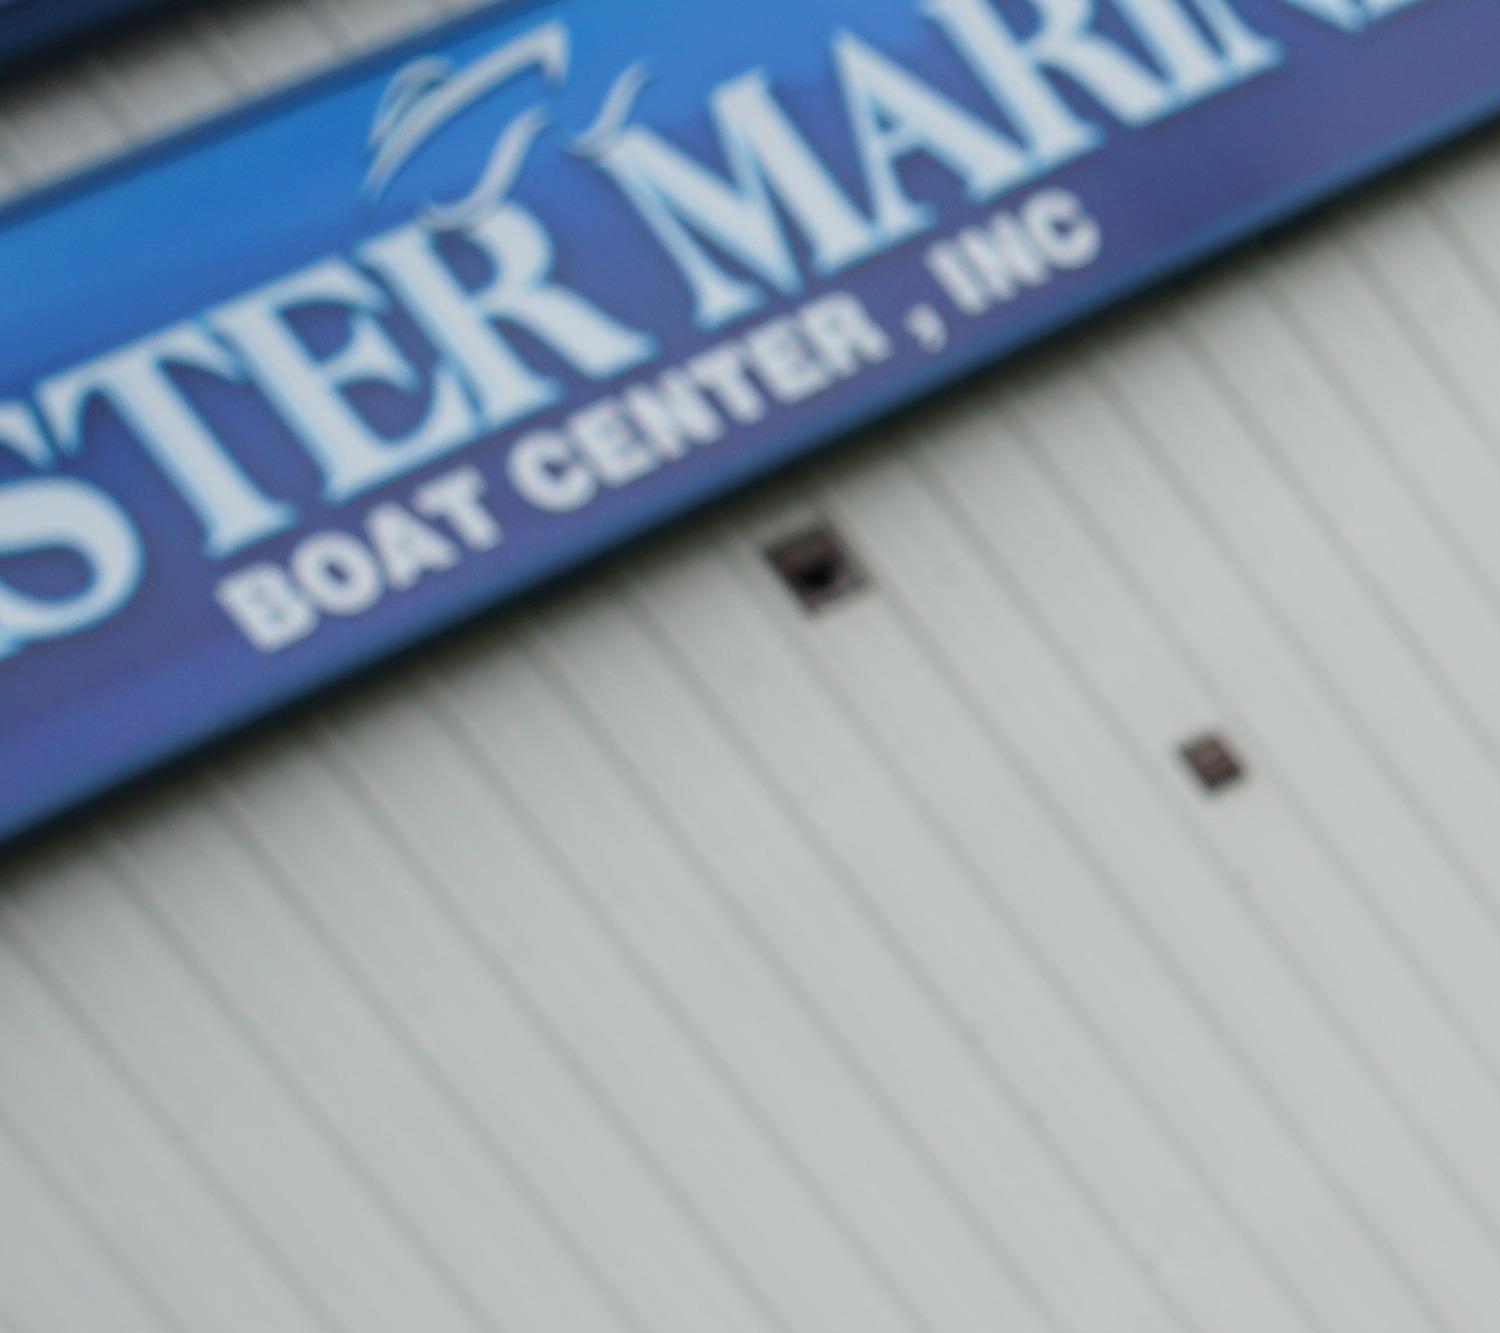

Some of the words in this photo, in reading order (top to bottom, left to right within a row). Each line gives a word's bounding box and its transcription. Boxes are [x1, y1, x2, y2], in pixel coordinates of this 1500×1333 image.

[214, 461, 501, 653] BOAT
[506, 291, 891, 512] CENTER
[924, 186, 1101, 315] INC
